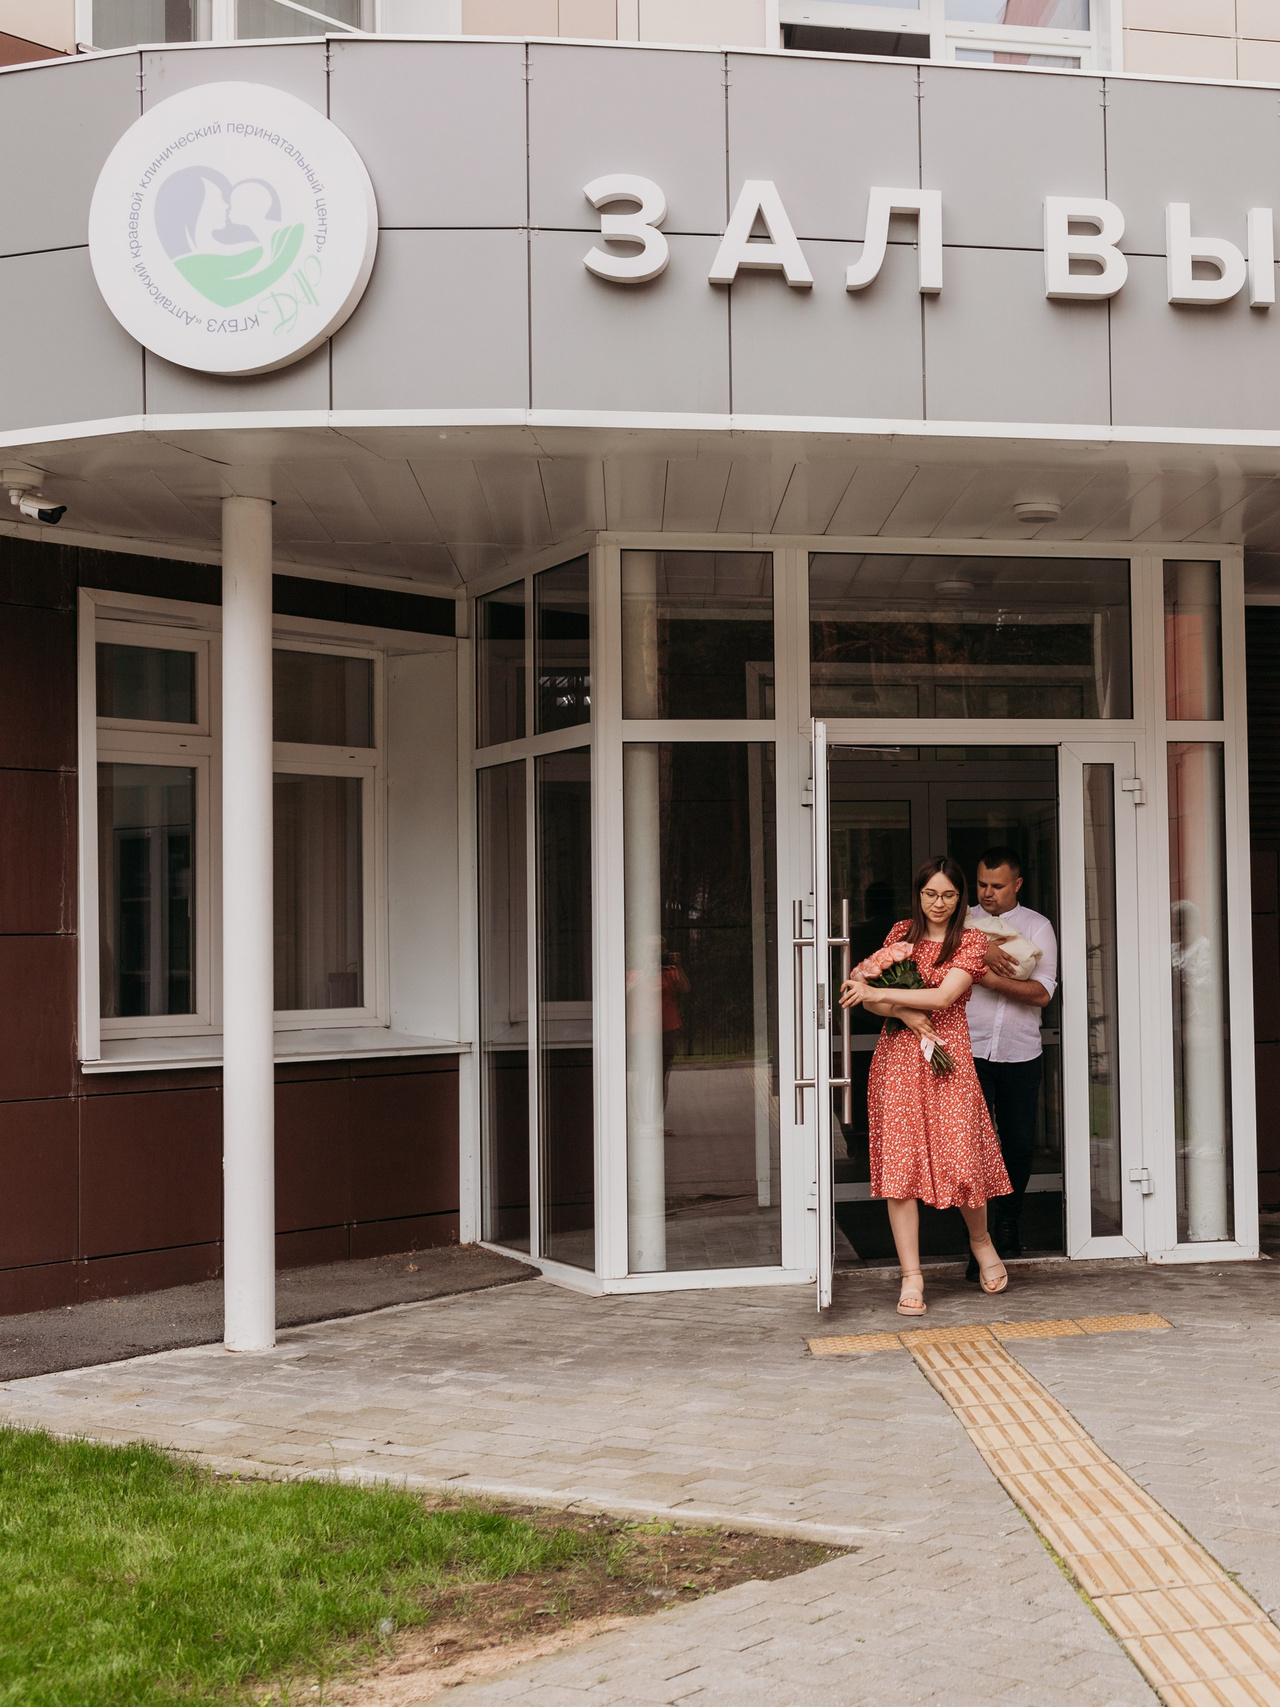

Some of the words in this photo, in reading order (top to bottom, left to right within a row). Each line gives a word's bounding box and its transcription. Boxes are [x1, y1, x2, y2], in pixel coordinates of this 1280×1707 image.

[140, 121, 222, 190] клинический
[226, 122, 324, 195] перинатальный
[129, 193, 145, 259] краевой
[314, 197, 328, 253] центр»
[583, 173, 943, 295] ЗАЛ
[132, 262, 202, 326] «Алтайский
[207, 314, 260, 333] КГБУЗ
